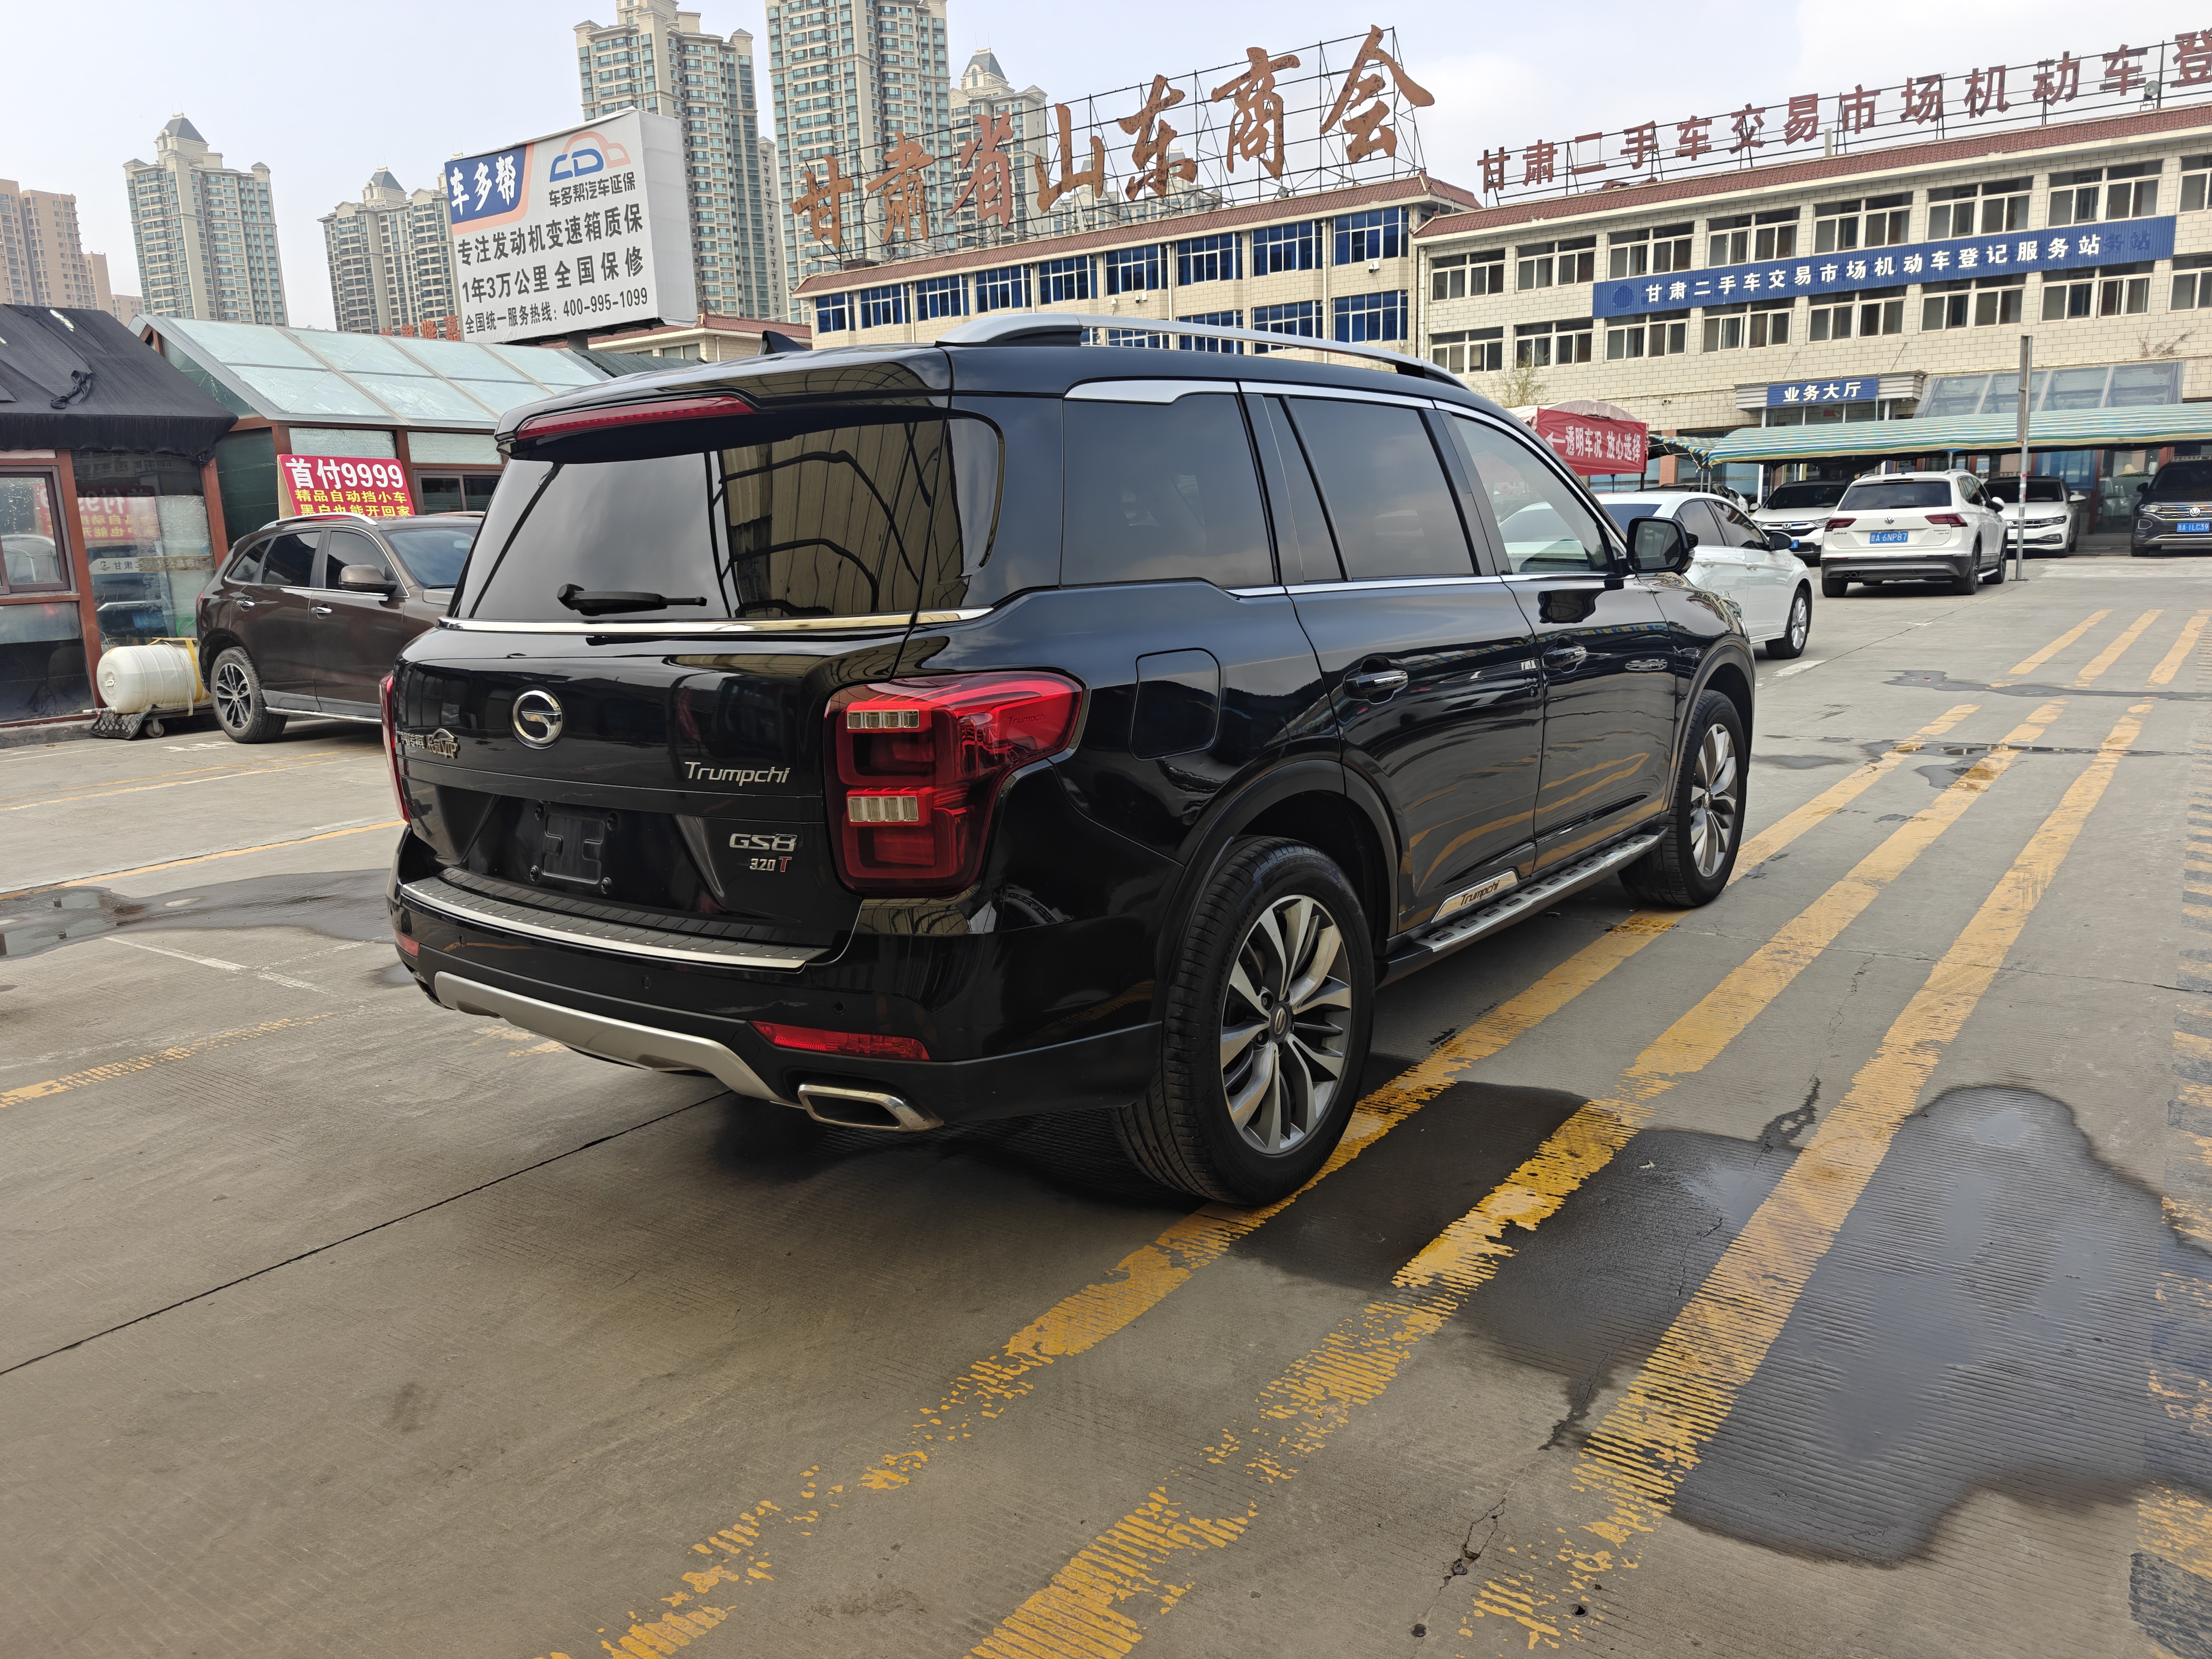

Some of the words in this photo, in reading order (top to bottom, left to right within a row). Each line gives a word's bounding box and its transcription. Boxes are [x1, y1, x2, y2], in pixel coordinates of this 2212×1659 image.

[1477, 27, 2212, 194] 甘肃二手车交易市场机动车登
[790, 24, 1434, 248] 甘肃省山东商会
[450, 154, 516, 216] 车多帮
[549, 171, 636, 207] 车多帮汽车延保
[457, 203, 643, 267] 专注发动机变速箱质保
[1645, 234, 2101, 303] 甘肃二手车交易市场机动车登记服务站
[1783, 381, 1862, 403] 业务大厅
[285, 457, 404, 490] 首付9999
[294, 489, 408, 504] 精品自动挡小车
[1008, 712, 1047, 725] Trumpch
[684, 761, 791, 787] Trumpchi
[729, 833, 798, 852] GS8
[1460, 879, 1500, 906] Trumpchi
